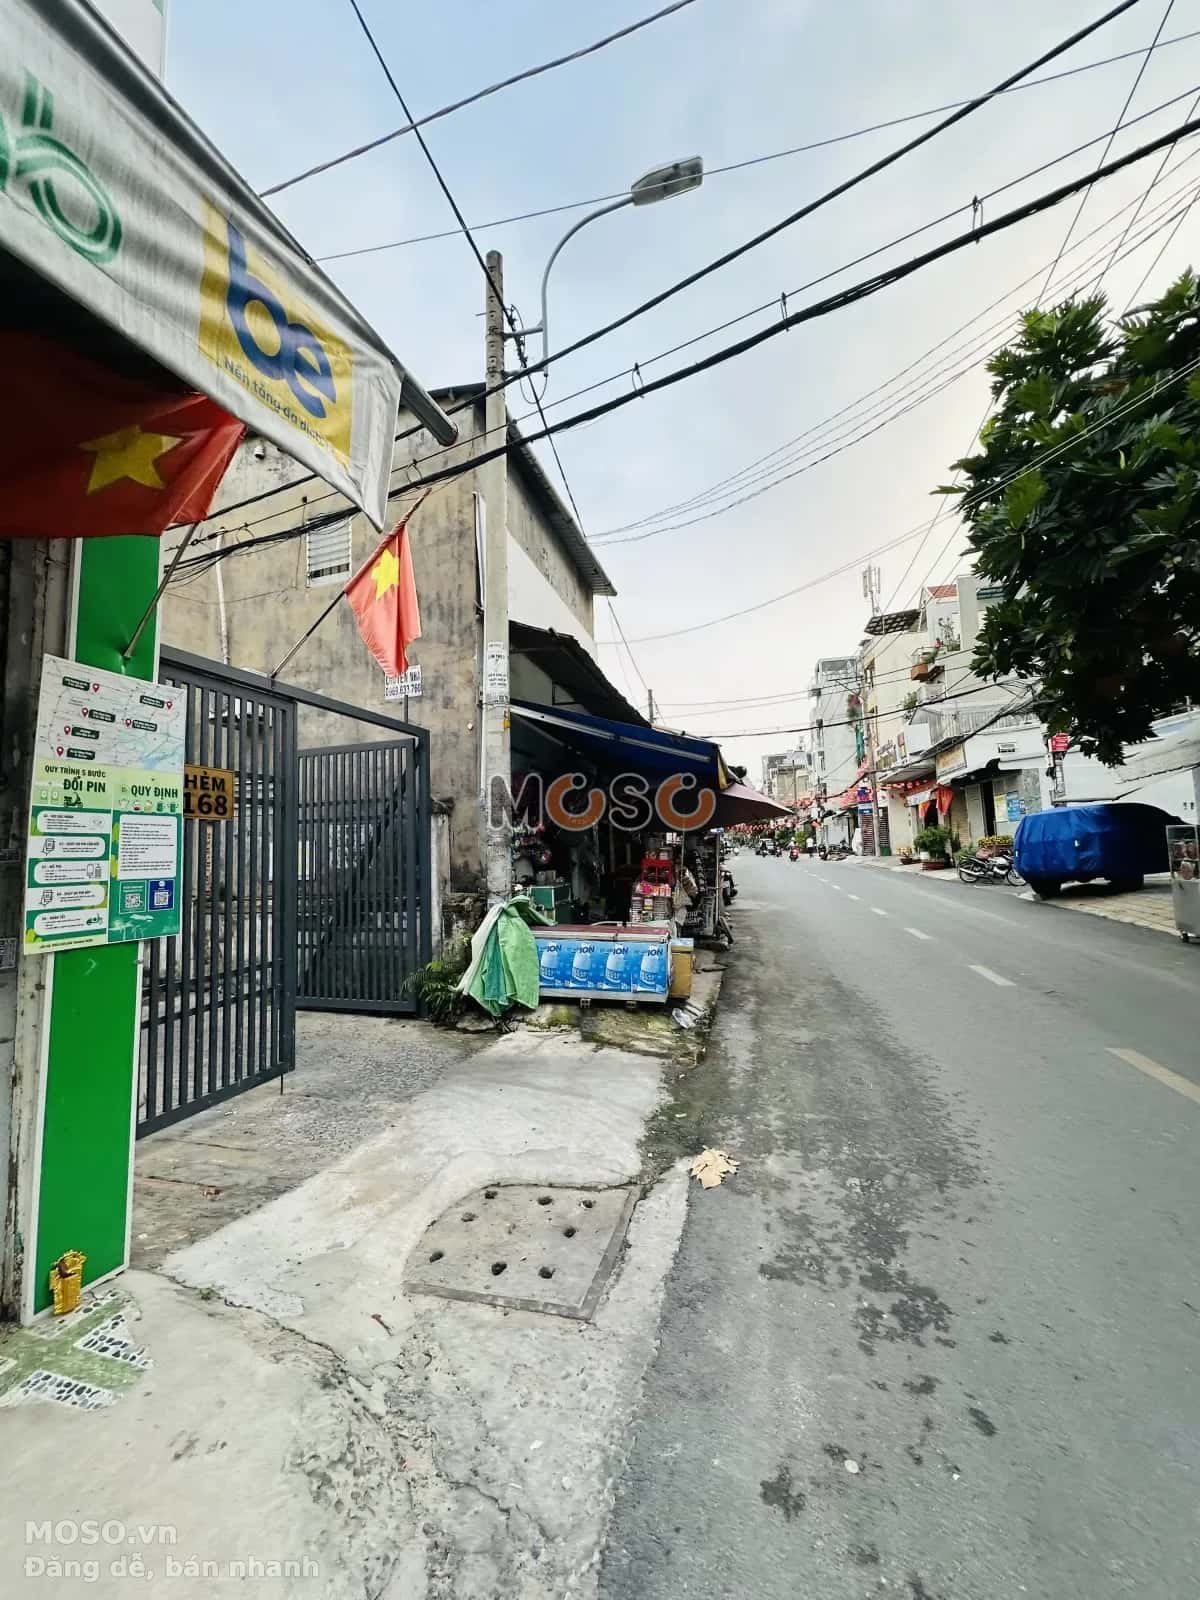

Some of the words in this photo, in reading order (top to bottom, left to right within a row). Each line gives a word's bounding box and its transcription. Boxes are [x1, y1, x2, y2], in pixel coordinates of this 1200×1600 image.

[226, 219, 337, 418] be
[45, 765, 58, 773] QUY
[60, 765, 80, 776] TRÌNH
[63, 775, 83, 791] ĐỔI
[86, 781, 106, 793] PIN
[184, 770, 226, 791] HẺM
[131, 785, 151, 797] QUY
[153, 786, 178, 800] ĐỊNH
[183, 791, 228, 816] 168
